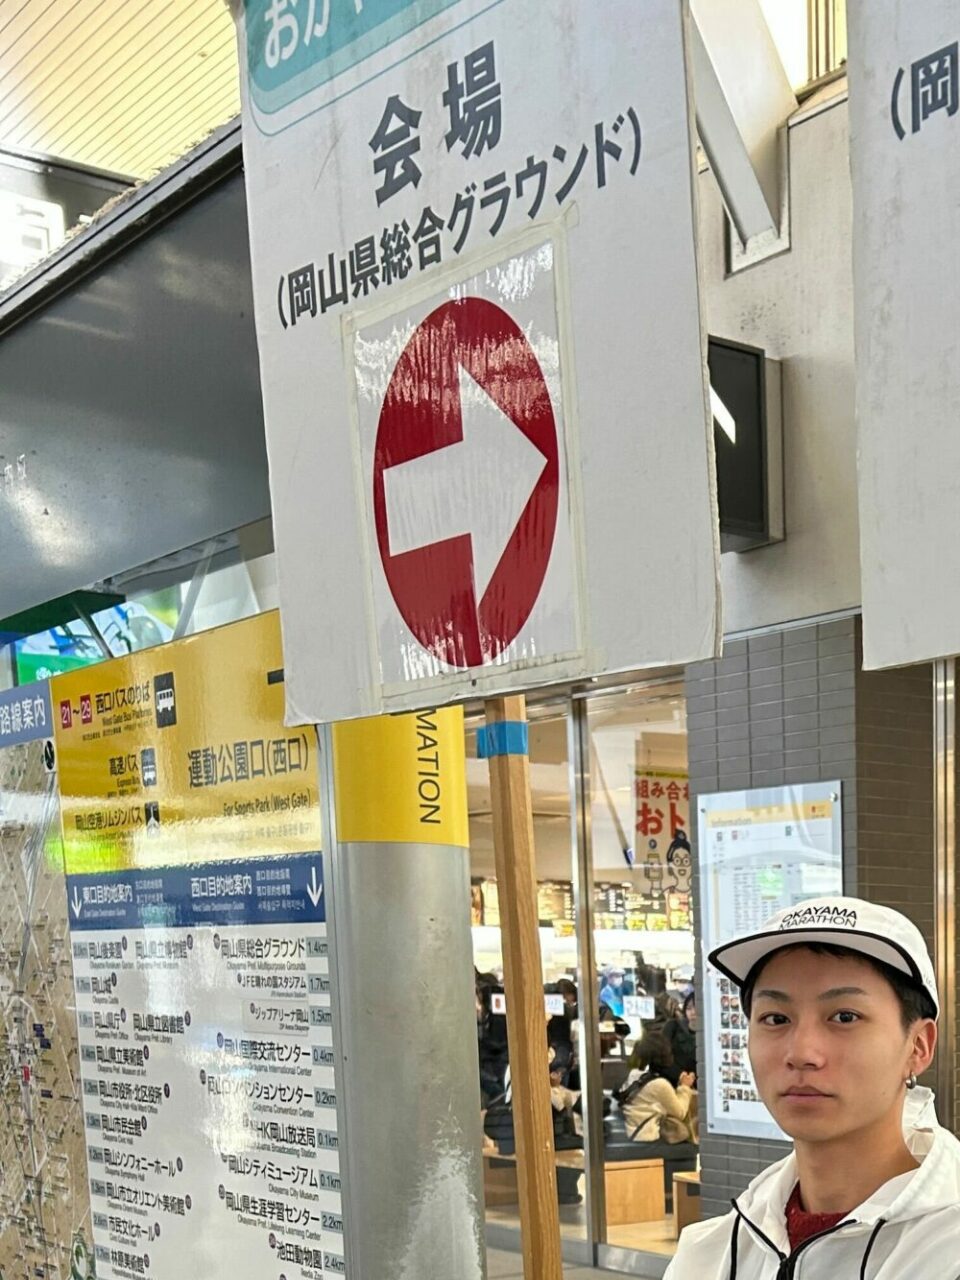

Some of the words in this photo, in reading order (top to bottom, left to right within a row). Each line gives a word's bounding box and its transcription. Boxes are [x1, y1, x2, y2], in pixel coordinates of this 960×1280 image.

[367, 40, 501, 208] 会場
[277, 107, 643, 329] (岡山県総合グラウンド)
[95, 680, 151, 715] 西口バスのりば
[109, 753, 139, 777] 高速バス
[187, 733, 309, 789] 運動公園口(西口)
[224, 802, 234, 815] For
[234, 801, 254, 815] Sports
[255, 798, 270, 813] Park
[190, 873, 253, 898] 西口目的地案内
[778, 914, 857, 931] MARATHON
[782, 906, 858, 923] OKAYAMA
[221, 937, 305, 959] 岡山県総合グラウンド
[255, 1007, 309, 1023] ジップアリーナ岡山
[104, 1148, 177, 1178] 岡山シンフォニーホール
[228, 1154, 318, 1188] 岡山シティミュージアム
[226, 1190, 320, 1226] 岡山県生涯学習センター
[276, 1239, 323, 1270] 池田動物園
